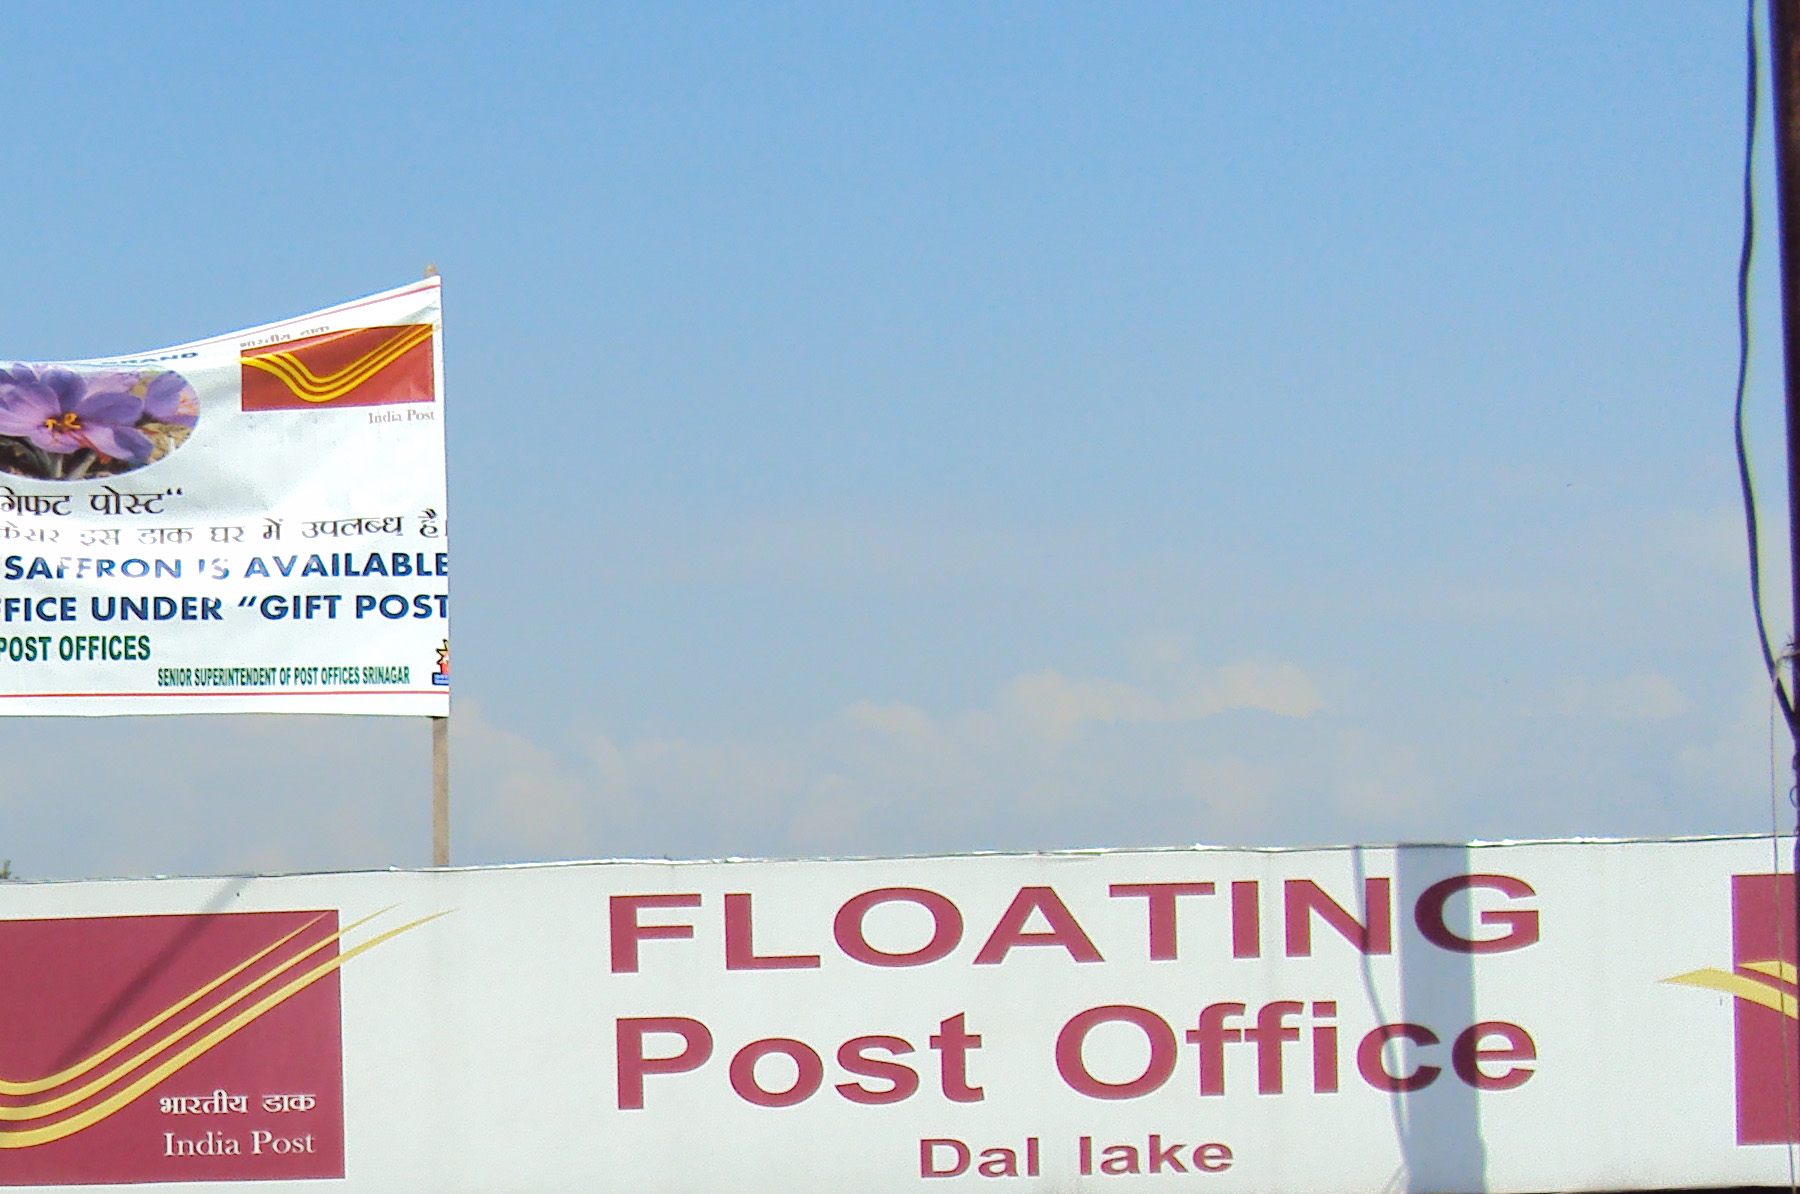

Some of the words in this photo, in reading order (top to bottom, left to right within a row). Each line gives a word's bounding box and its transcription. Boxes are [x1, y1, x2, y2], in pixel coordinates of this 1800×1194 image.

[406, 409, 435, 421] Post
[209, 526, 245, 544] घर
[301, 516, 405, 539] उपलब्ध
[4, 556, 182, 581] SAFFRON
[199, 557, 231, 580] IS
[243, 552, 448, 578] AVAILABLE
[91, 595, 224, 621] UNDER
[238, 594, 343, 620] “GIFT
[355, 593, 448, 620] POST
[58, 635, 152, 661] OFFICES
[157, 667, 193, 687] SENIOR
[194, 667, 278, 687] SUPERINTENDENT
[279, 667, 292, 686] OF
[294, 667, 319, 686] POST
[321, 666, 361, 686] OFFICES
[362, 665, 411, 685] SRINAGAR
[610, 875, 1538, 972] FLOATING
[616, 1012, 984, 1109] Post
[1055, 1000, 1536, 1098] Office
[159, 1089, 249, 1115] भारतीय
[262, 1093, 317, 1113] डाक
[164, 1131, 242, 1157] India
[251, 1130, 317, 1155] Post
[920, 1137, 1042, 1177] Dal
[1079, 1136, 1230, 1174] lake
